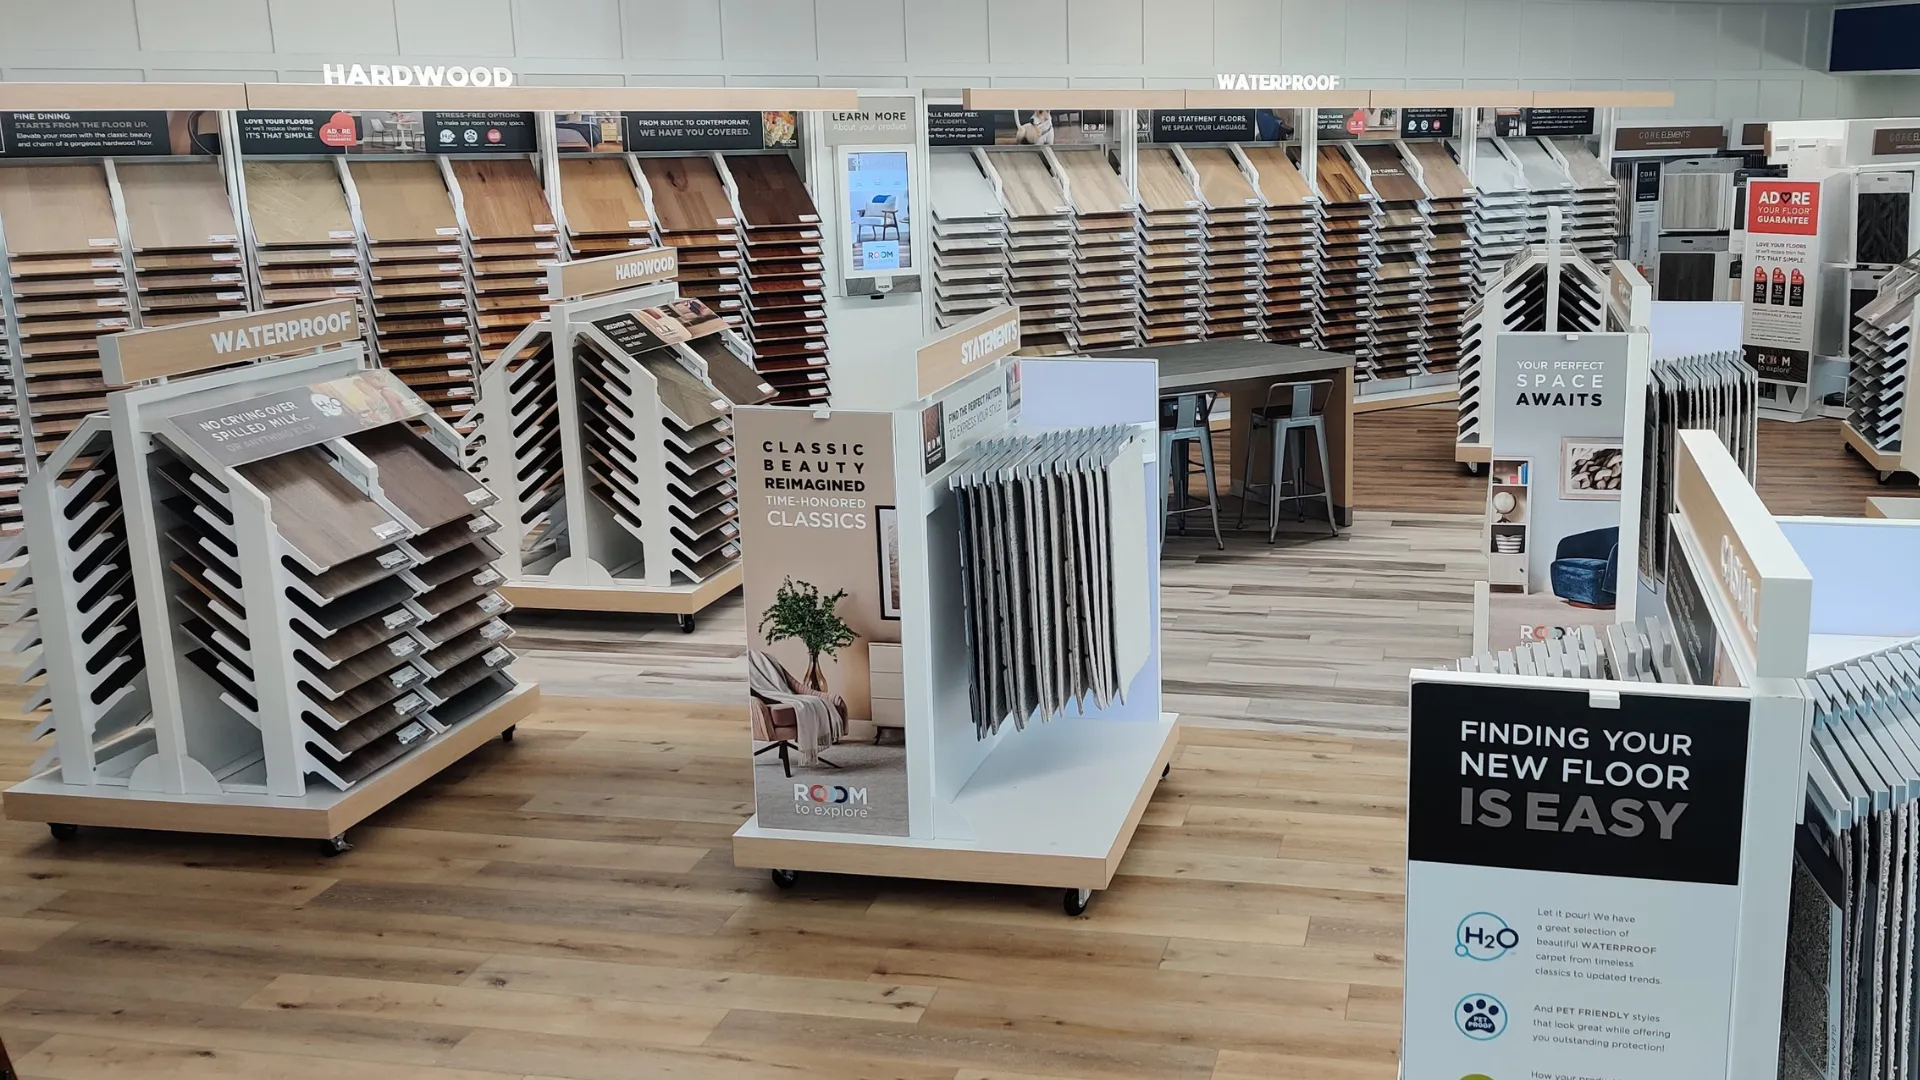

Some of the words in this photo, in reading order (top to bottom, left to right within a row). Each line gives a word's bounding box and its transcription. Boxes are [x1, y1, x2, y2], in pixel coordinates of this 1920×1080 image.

[322, 63, 513, 87] HARDWOOD
[1217, 73, 1340, 91] WATERPROOF
[832, 112, 870, 121] LEARN
[875, 112, 907, 121] MORE
[1178, 115, 1217, 123] STATEMENT
[1219, 115, 1247, 123] FLOORS,
[685, 128, 704, 136] YOU
[833, 122, 857, 131] About
[859, 123, 876, 132] your
[878, 123, 907, 132] product
[1161, 124, 1172, 132] WE
[1173, 124, 1194, 132] SPEAK
[1638, 130, 1660, 140] CORE
[42, 133, 58, 141] your
[129, 131, 153, 140] beauty
[70, 140, 102, 148] gorgeous
[1757, 206, 1780, 214] YOUR
[1757, 215, 1809, 225] GUARANTEE
[616, 257, 675, 281] HARDWOOD
[212, 311, 352, 354] WATERPROOF
[961, 319, 1017, 366] STATEMENTS
[1516, 360, 1548, 370] YOUR
[1554, 360, 1605, 370] PERFECT
[1757, 363, 1765, 371] to
[1516, 373, 1603, 388] SPACE
[947, 411, 959, 424] FIND
[959, 407, 968, 419] THE
[967, 397, 985, 416] PERFECT
[985, 387, 1002, 405] PATTERN
[1516, 392, 1602, 407] AWAITS
[199, 420, 220, 432] NO
[221, 408, 266, 427] CRYING
[264, 401, 299, 417] OVER
[957, 416, 977, 437] EXPRESS
[976, 410, 989, 426] YOUR
[210, 422, 266, 442] SPILLED
[762, 440, 864, 456] CLASSIC
[763, 459, 865, 474] BEAUTY
[764, 477, 866, 492] REIMAGINED
[765, 495, 867, 509] TIME-HONORED
[767, 510, 867, 529] CLASSICS
[1460, 720, 1590, 750] FINDING
[1602, 729, 1693, 757] YOUR
[1460, 751, 1549, 780] NEW
[1561, 758, 1690, 791] FLOOR
[793, 783, 868, 805] ROOM
[795, 803, 810, 815] to
[1460, 787, 1513, 828] IS
[1525, 791, 1689, 840] EASY
[1537, 908, 1553, 918] Let
[1555, 908, 1563, 918] it
[1564, 910, 1591, 921] pour!
[1593, 912, 1610, 922] We
[1611, 912, 1637, 924] have
[1465, 926, 1520, 950] H2O
[1544, 924, 1571, 936] great
[1572, 925, 1618, 937] selection
[1618, 929, 1630, 938] of
[1536, 937, 1579, 950] beautiful
[1580, 940, 1657, 955] WATERPROOF
[1535, 953, 1567, 965] carpet
[1568, 954, 1593, 965] from
[1594, 957, 1635, 969] timeless
[1534, 966, 1572, 979] classics
[1572, 969, 1583, 979] to
[1585, 970, 1628, 983] updated
[1628, 973, 1663, 985] trends.
[1473, 1015, 1488, 1023] PET
[1533, 1004, 1554, 1014] And
[1555, 1007, 1576, 1016] PET
[1577, 1008, 1631, 1021] FRIENDLY
[1631, 1012, 1661, 1024] styles
[1532, 1018, 1553, 1029] that
[1554, 1020, 1576, 1031] look
[1577, 1023, 1605, 1035] great
[1605, 1024, 1631, 1036] while
[1632, 1027, 1672, 1040] offering
[1532, 1034, 1551, 1044] you
[1552, 1035, 1610, 1050] outstanding
[1610, 1040, 1666, 1054] protection!
[1531, 1070, 1552, 1080] How
